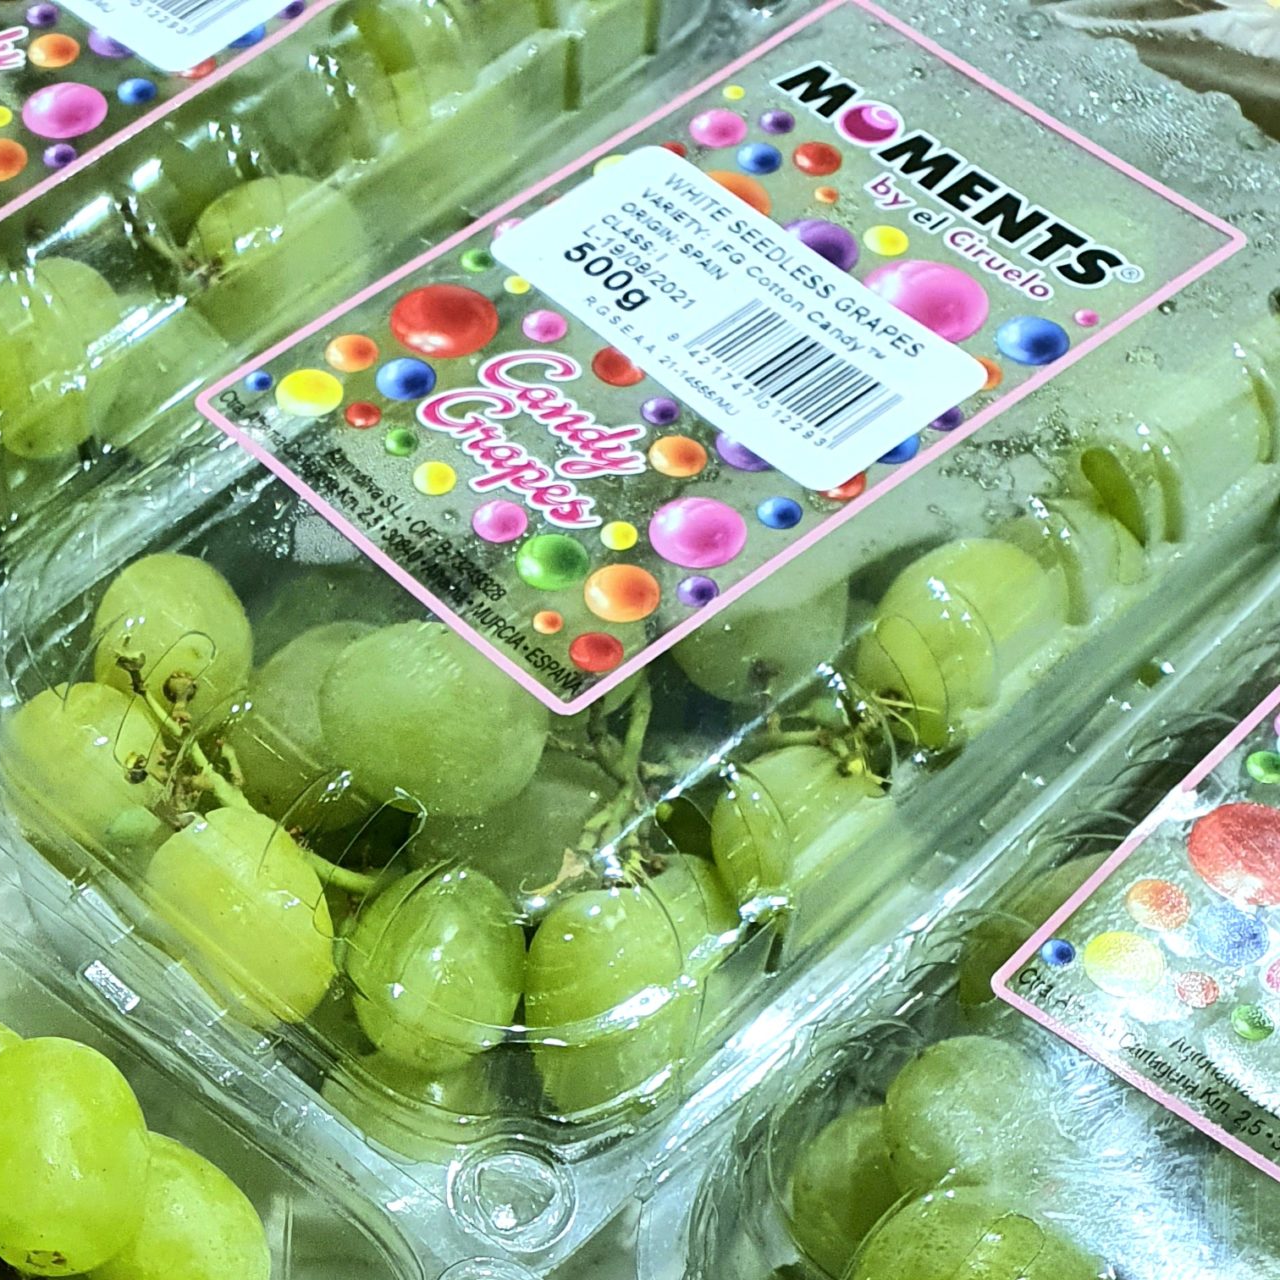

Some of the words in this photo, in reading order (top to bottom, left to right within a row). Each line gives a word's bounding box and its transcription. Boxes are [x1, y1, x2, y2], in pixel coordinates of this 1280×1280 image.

[563, 242, 651, 312] 500g
[642, 187, 711, 240] VARIETY:
[711, 239, 746, 268] IFG
[746, 265, 805, 313] Cotton
[665, 172, 732, 222] WHITE
[728, 216, 837, 300] SEEDLESS
[834, 297, 926, 359] GRAPES
[679, 243, 728, 281] SPAIN
[869, 176, 910, 209] by
[914, 207, 949, 233] el
[949, 230, 1050, 300] Ciruelo
[421, 390, 604, 527] Grapes
[482, 355, 647, 478] Candy
[472, 600, 527, 651] MURCIA
[525, 646, 583, 696] ESPAÑA
